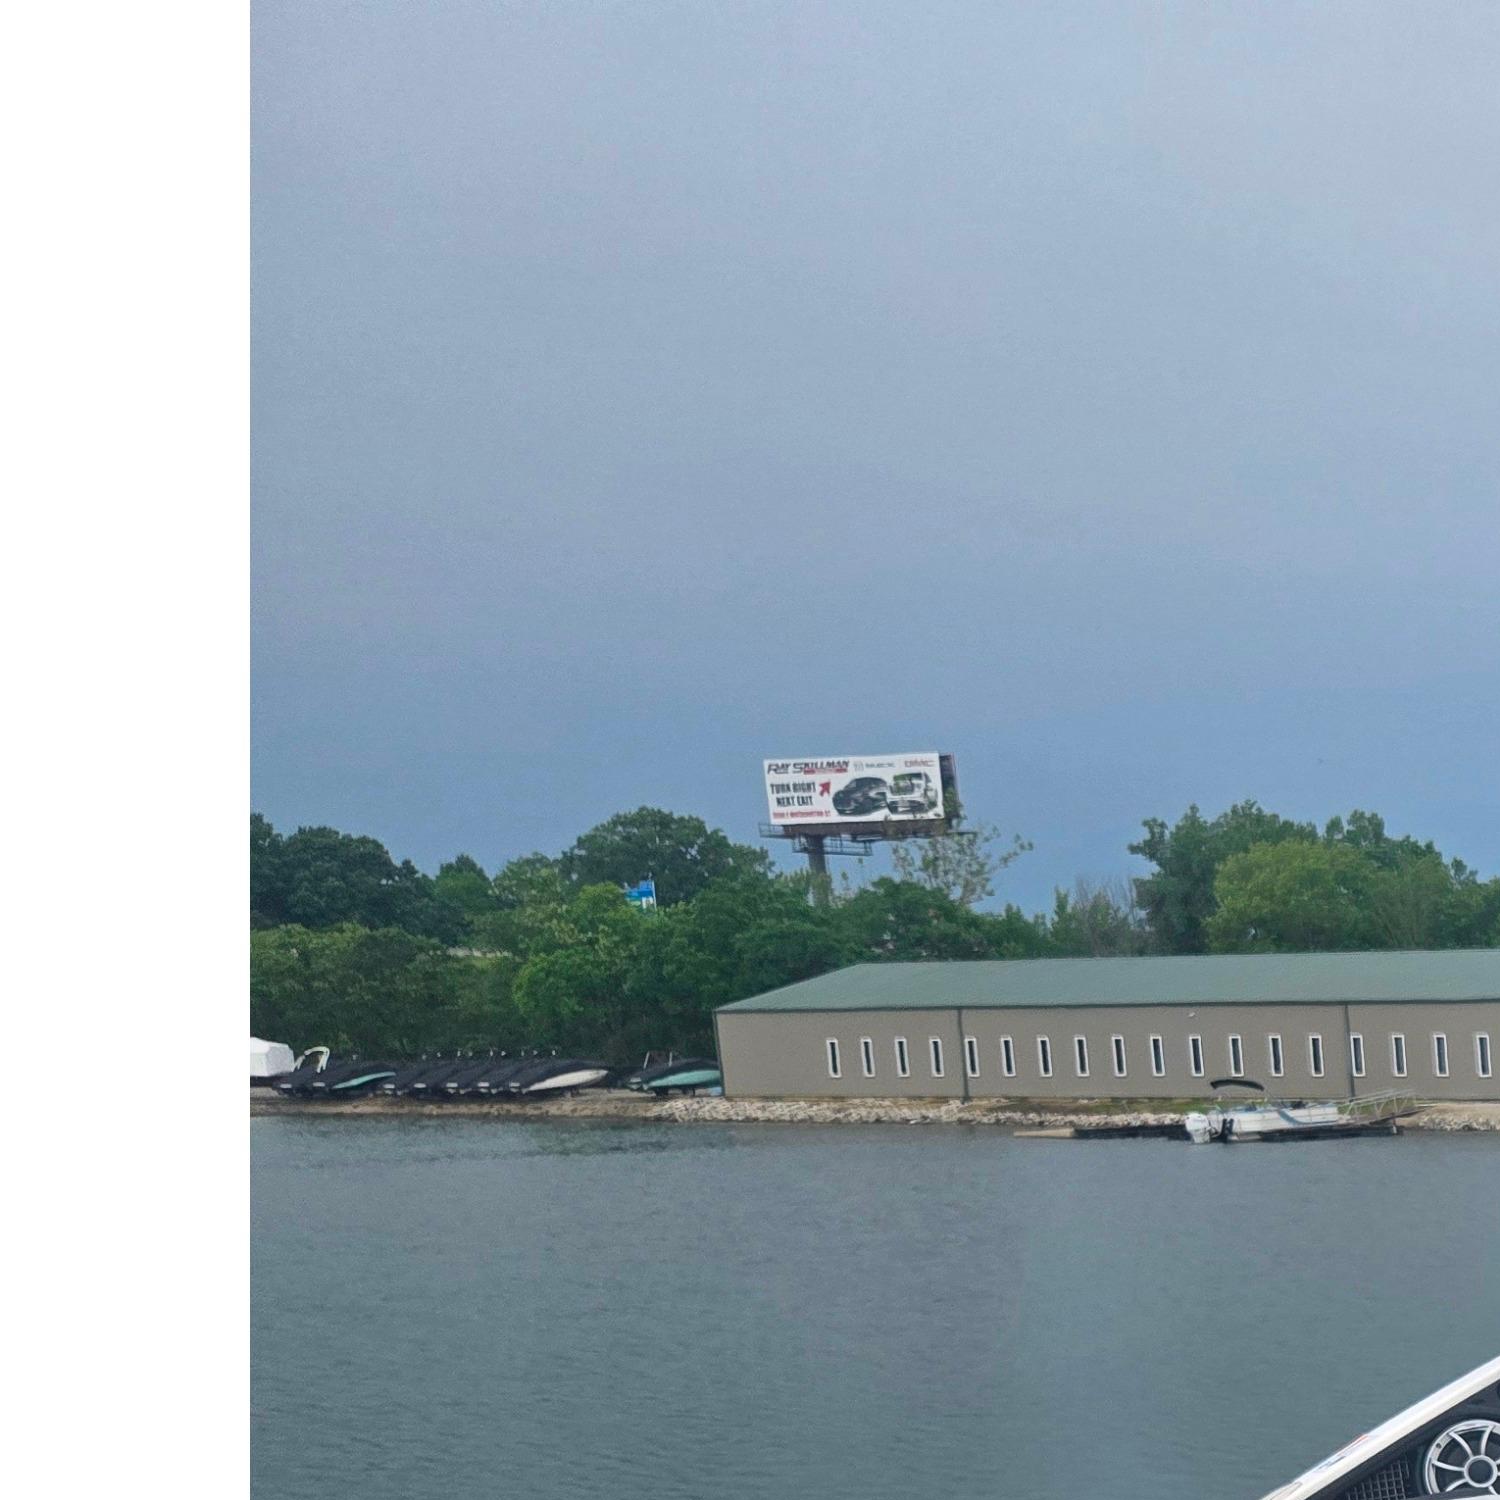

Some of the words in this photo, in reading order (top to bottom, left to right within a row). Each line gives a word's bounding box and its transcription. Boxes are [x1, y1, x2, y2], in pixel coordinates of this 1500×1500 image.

[792, 760, 849, 775] SKILLMAN
[770, 783, 791, 795] TURN
[792, 781, 817, 793] RIGHT
[776, 796, 795, 807] NEXT
[797, 795, 813, 806] EXIT
